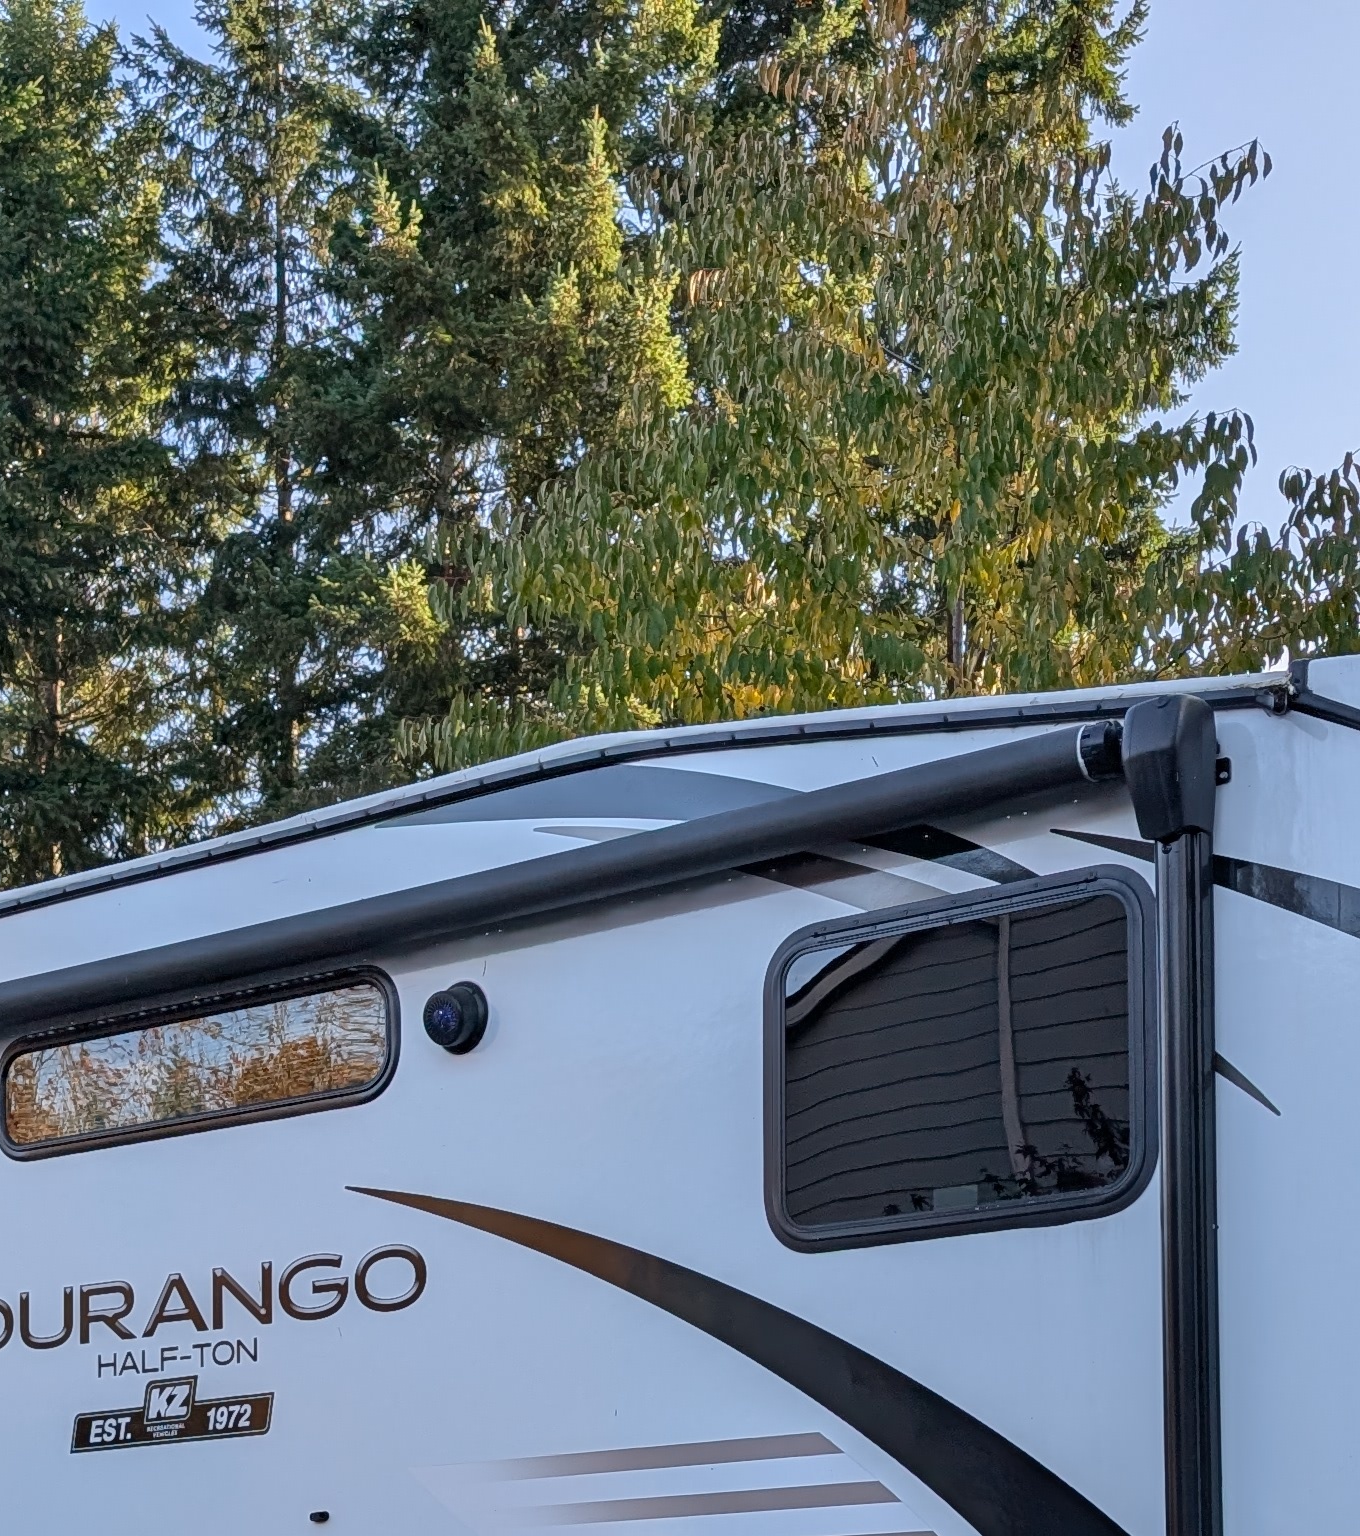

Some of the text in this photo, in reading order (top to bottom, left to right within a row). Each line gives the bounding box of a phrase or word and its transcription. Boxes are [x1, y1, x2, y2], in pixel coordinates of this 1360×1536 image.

[97, 1336, 259, 1378] HALF-TON
[148, 1384, 191, 1420] KZ
[89, 1403, 252, 1444] EST. 1972
